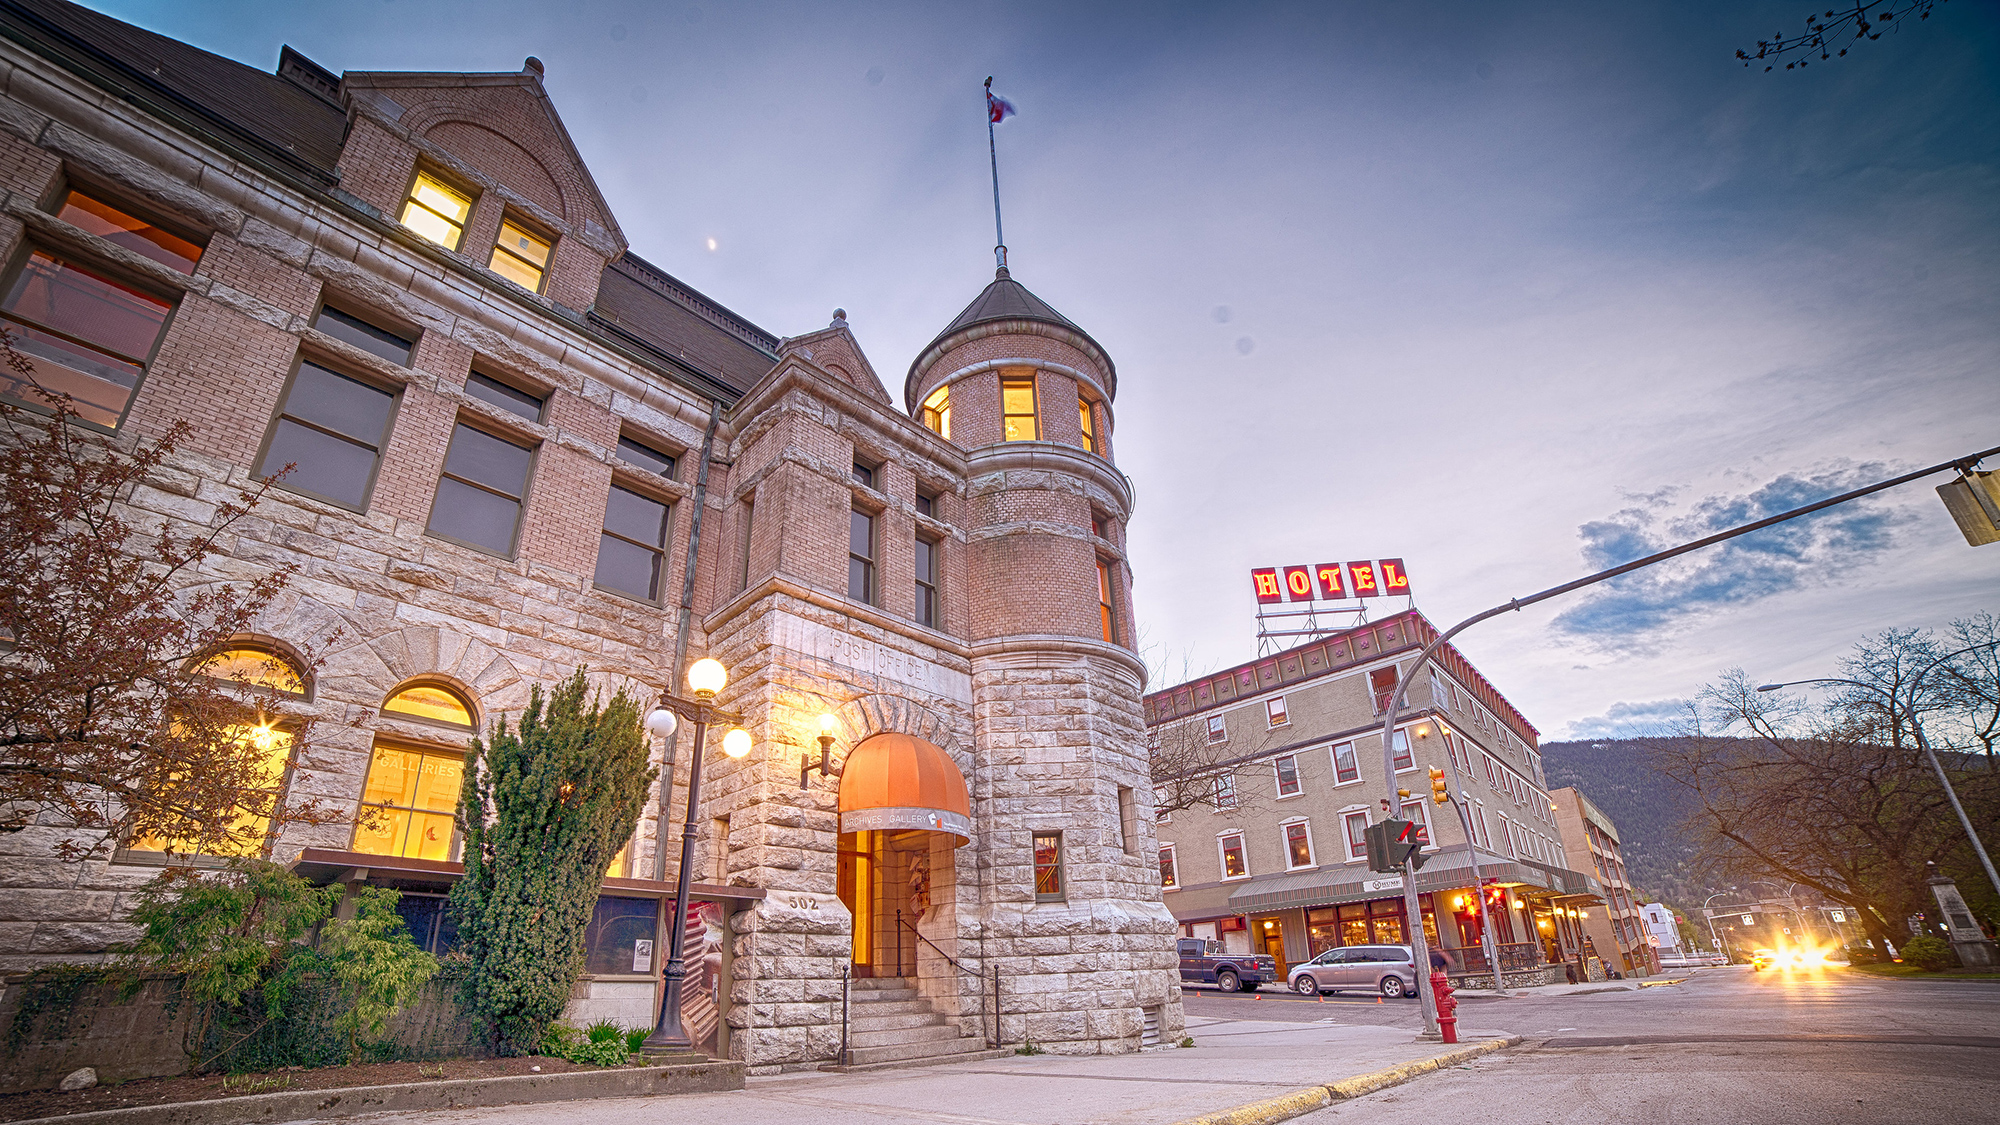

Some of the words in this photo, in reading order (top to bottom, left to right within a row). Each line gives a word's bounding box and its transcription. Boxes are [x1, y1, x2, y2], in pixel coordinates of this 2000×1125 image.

[1254, 564, 1407, 596] HOTEL
[833, 638, 869, 663] POST
[879, 653, 922, 680] OFFICE
[380, 757, 455, 777] GALLERIES
[844, 815, 883, 826] ARCHIVES
[889, 814, 927, 823] GALLERY
[789, 896, 818, 910] 502
